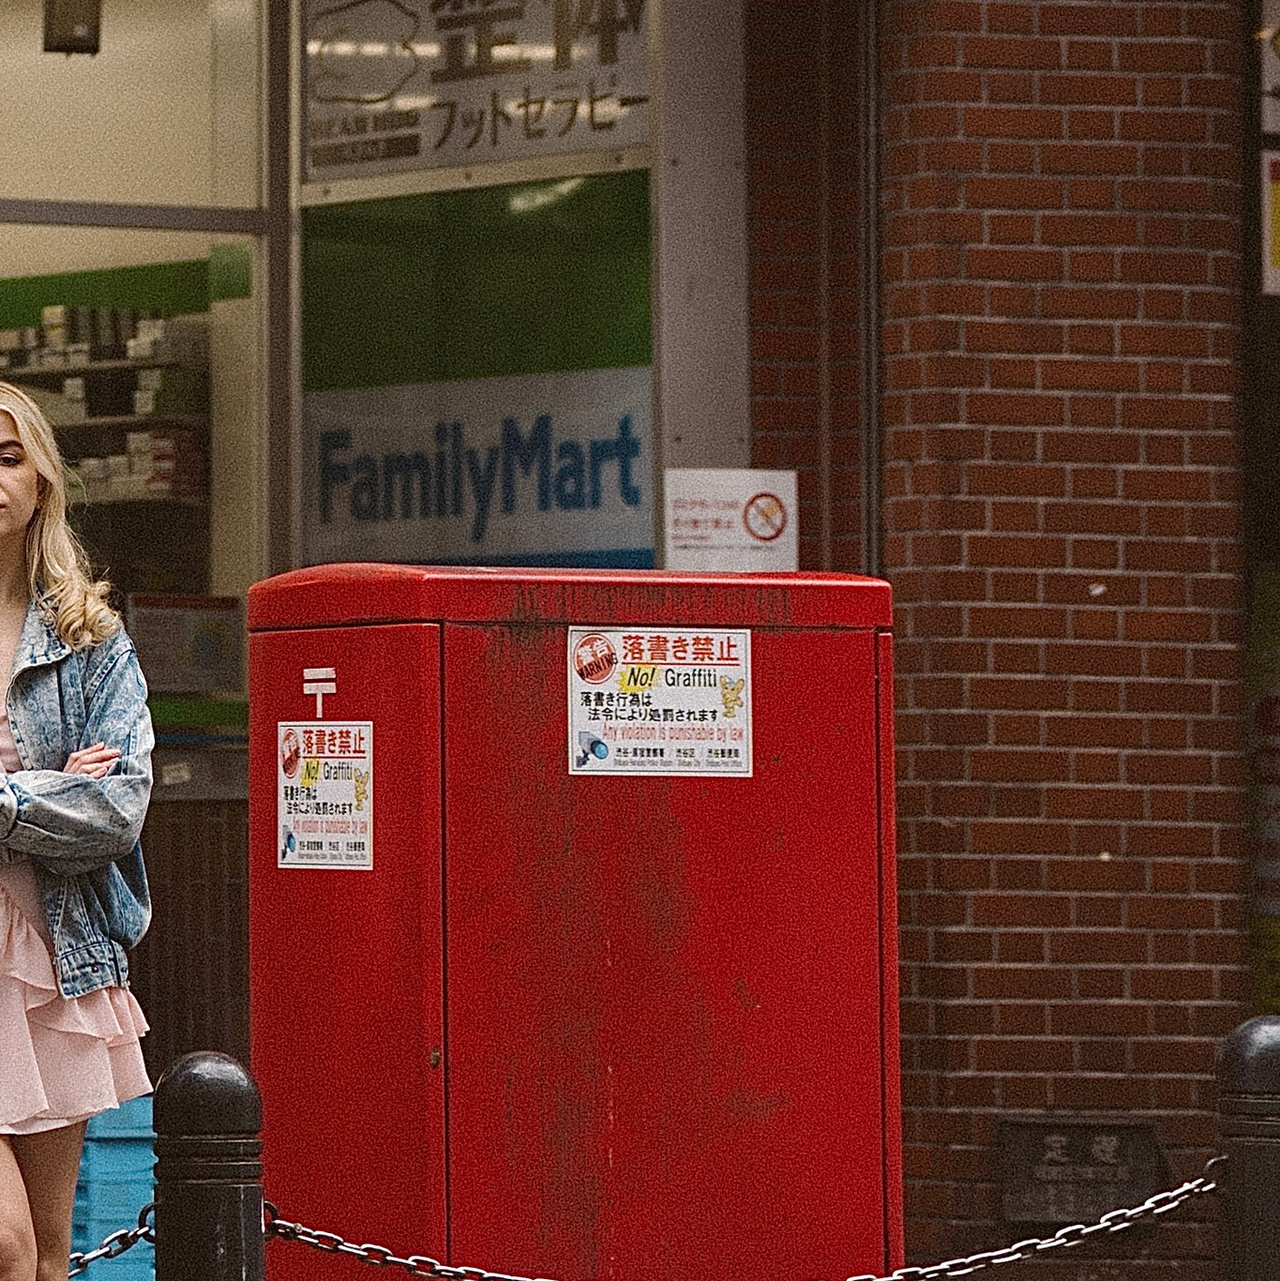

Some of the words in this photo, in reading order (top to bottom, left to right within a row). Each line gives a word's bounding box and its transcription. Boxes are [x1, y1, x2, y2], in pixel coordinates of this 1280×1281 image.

[431, 76, 650, 151] フットセラピー
[319, 413, 642, 544] FamilyMart
[621, 634, 739, 663] 落書き禁止
[626, 666, 658, 688] No!
[663, 668, 719, 688] Graffiti
